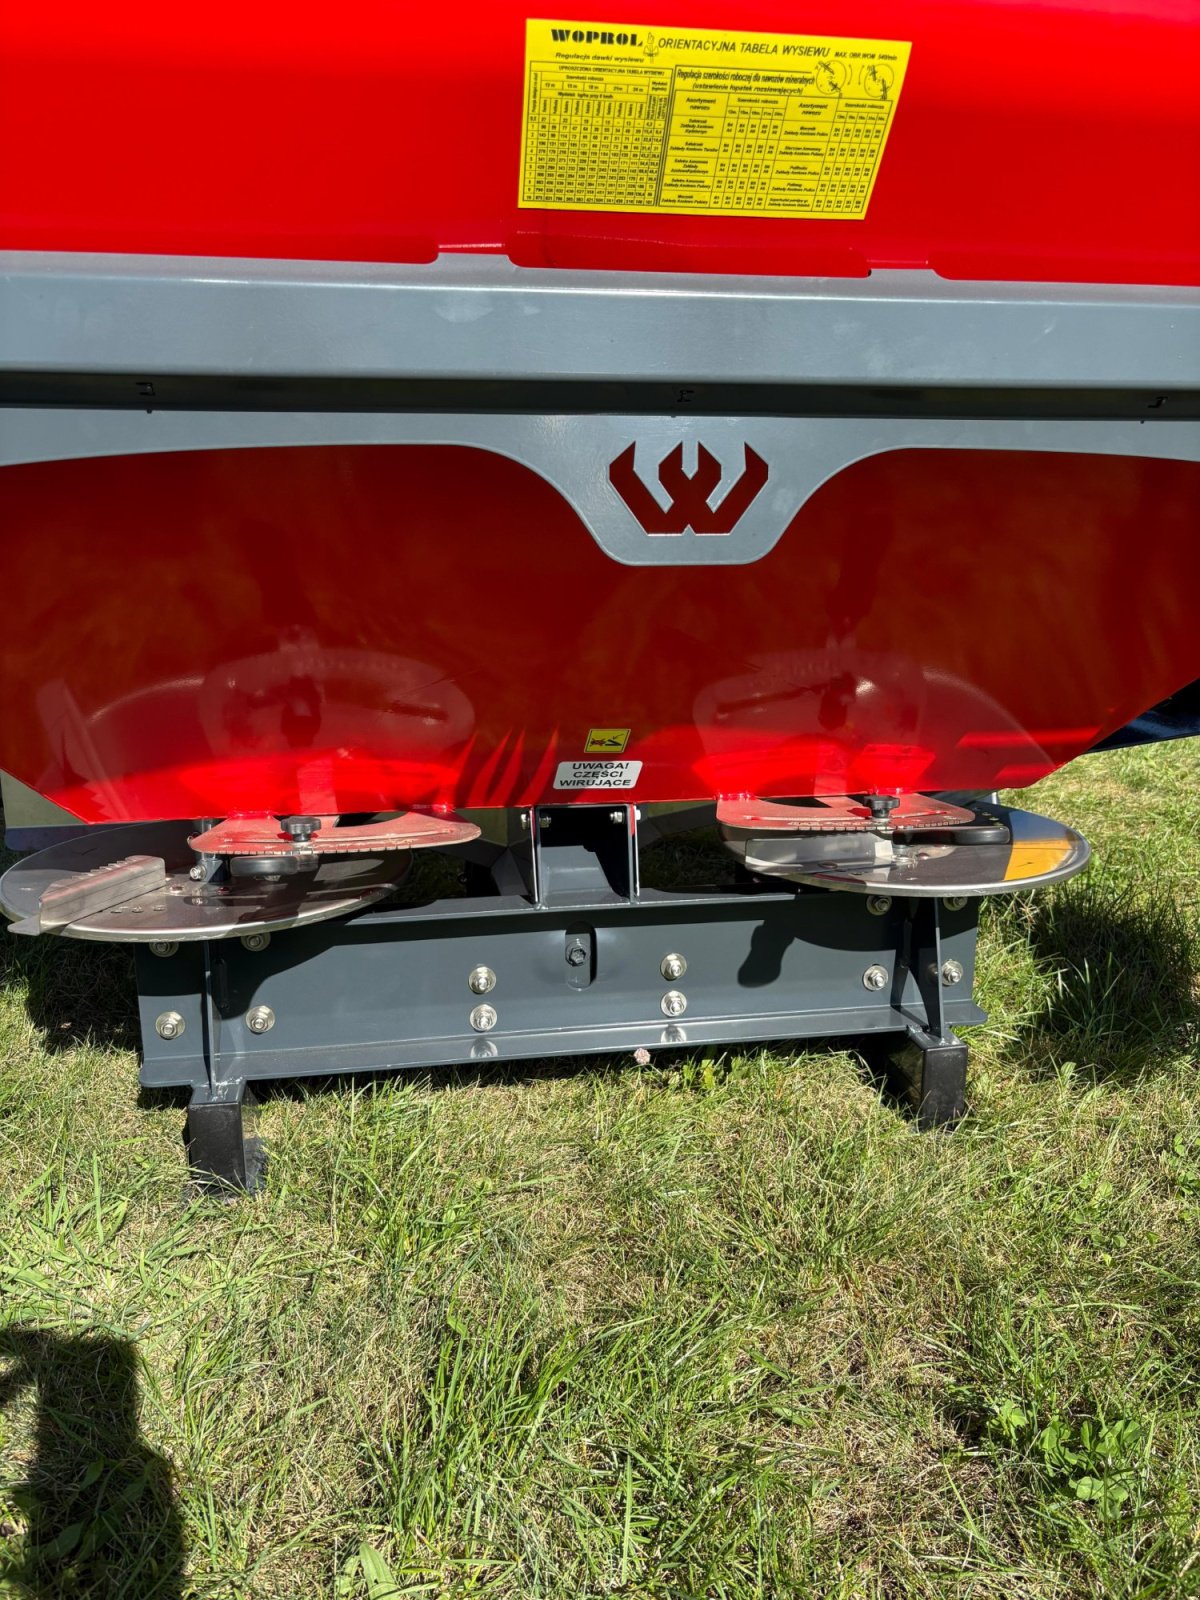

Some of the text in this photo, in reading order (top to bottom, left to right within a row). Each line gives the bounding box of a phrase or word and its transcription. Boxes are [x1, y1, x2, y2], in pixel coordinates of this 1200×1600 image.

[551, 28, 643, 47] WOPROL
[556, 52, 590, 60] Regulacja
[658, 38, 830, 58] ORIENTACYJNA TABELA WYSIEWU
[676, 69, 702, 81] Regulacja
[702, 71, 730, 80] szerokości
[730, 73, 752, 84] roboczej
[761, 74, 784, 83] nawozów
[785, 76, 814, 86] mineralnych
[573, 770, 623, 778] CZĘŚCI
